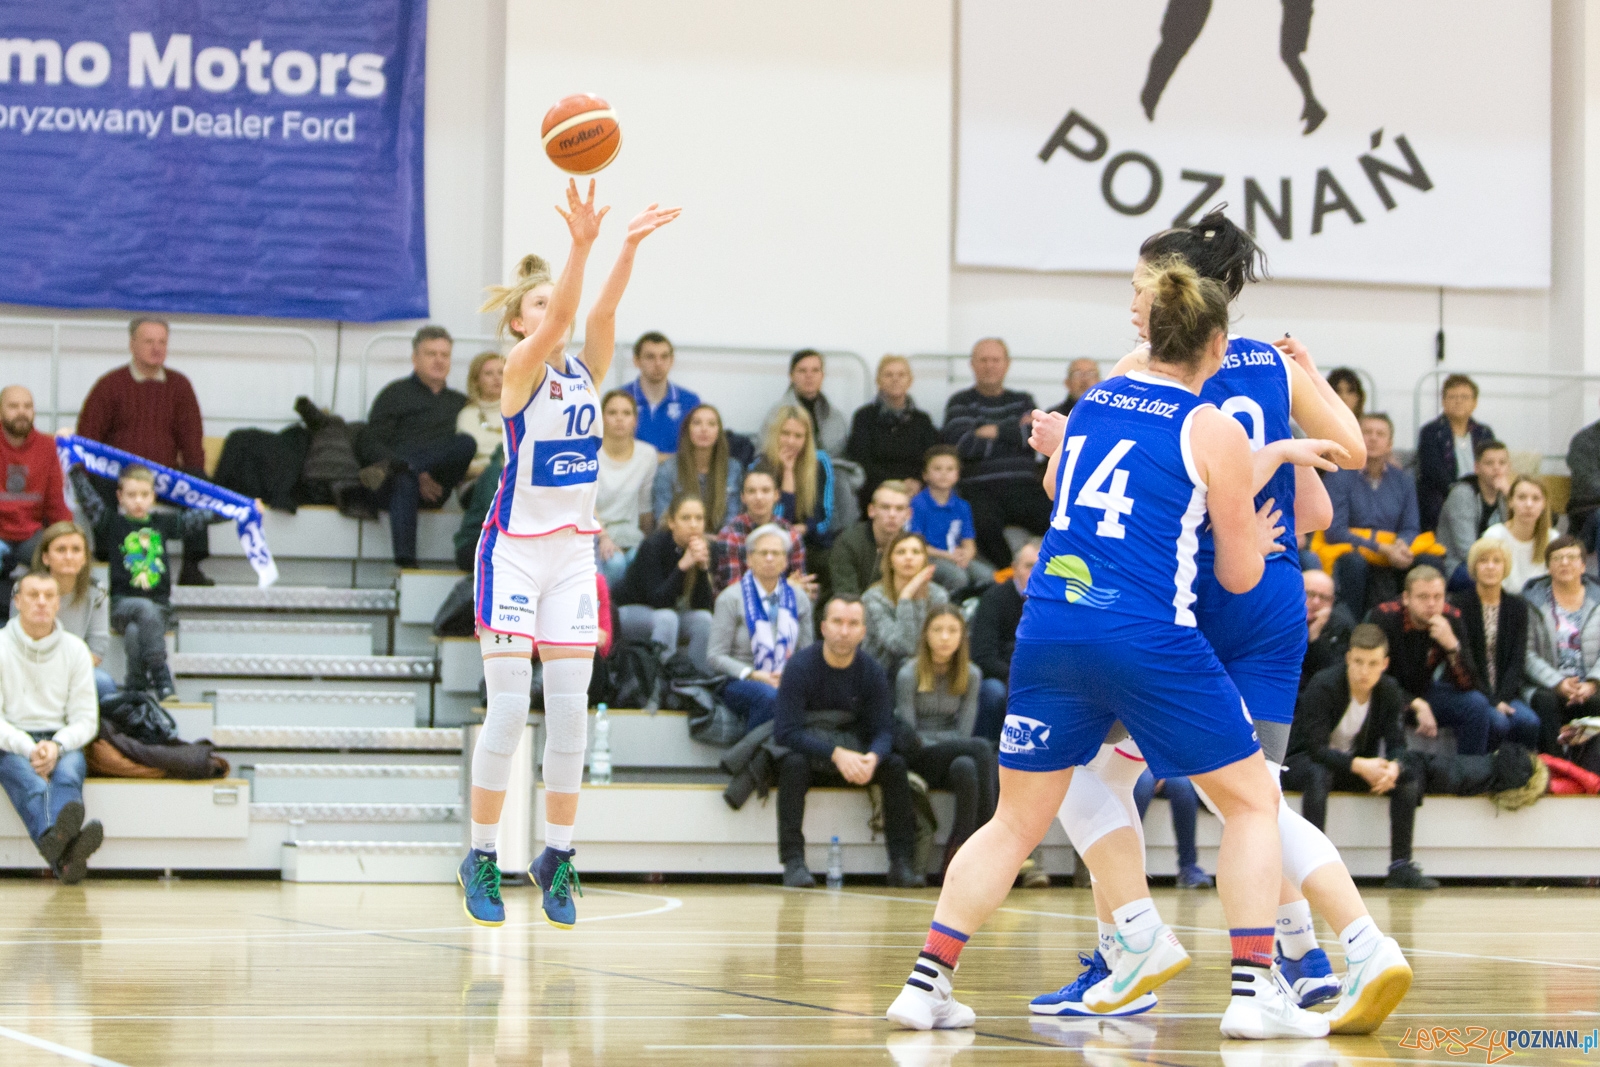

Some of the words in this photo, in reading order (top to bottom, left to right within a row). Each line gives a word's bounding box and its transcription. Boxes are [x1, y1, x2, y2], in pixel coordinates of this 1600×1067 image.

[128, 31, 387, 97] Motors
[171, 106, 274, 138] Dealer
[283, 111, 355, 142] Ford
[559, 124, 605, 150] molten
[1037, 108, 1434, 240] POZNAŃ
[1220, 353, 1241, 369] MS
[563, 403, 596, 437] 10
[1109, 394, 1140, 410] SMS
[1137, 398, 1180, 418] ŁÓDŹ
[553, 459, 598, 476] Enea
[1050, 434, 1137, 539] 14
